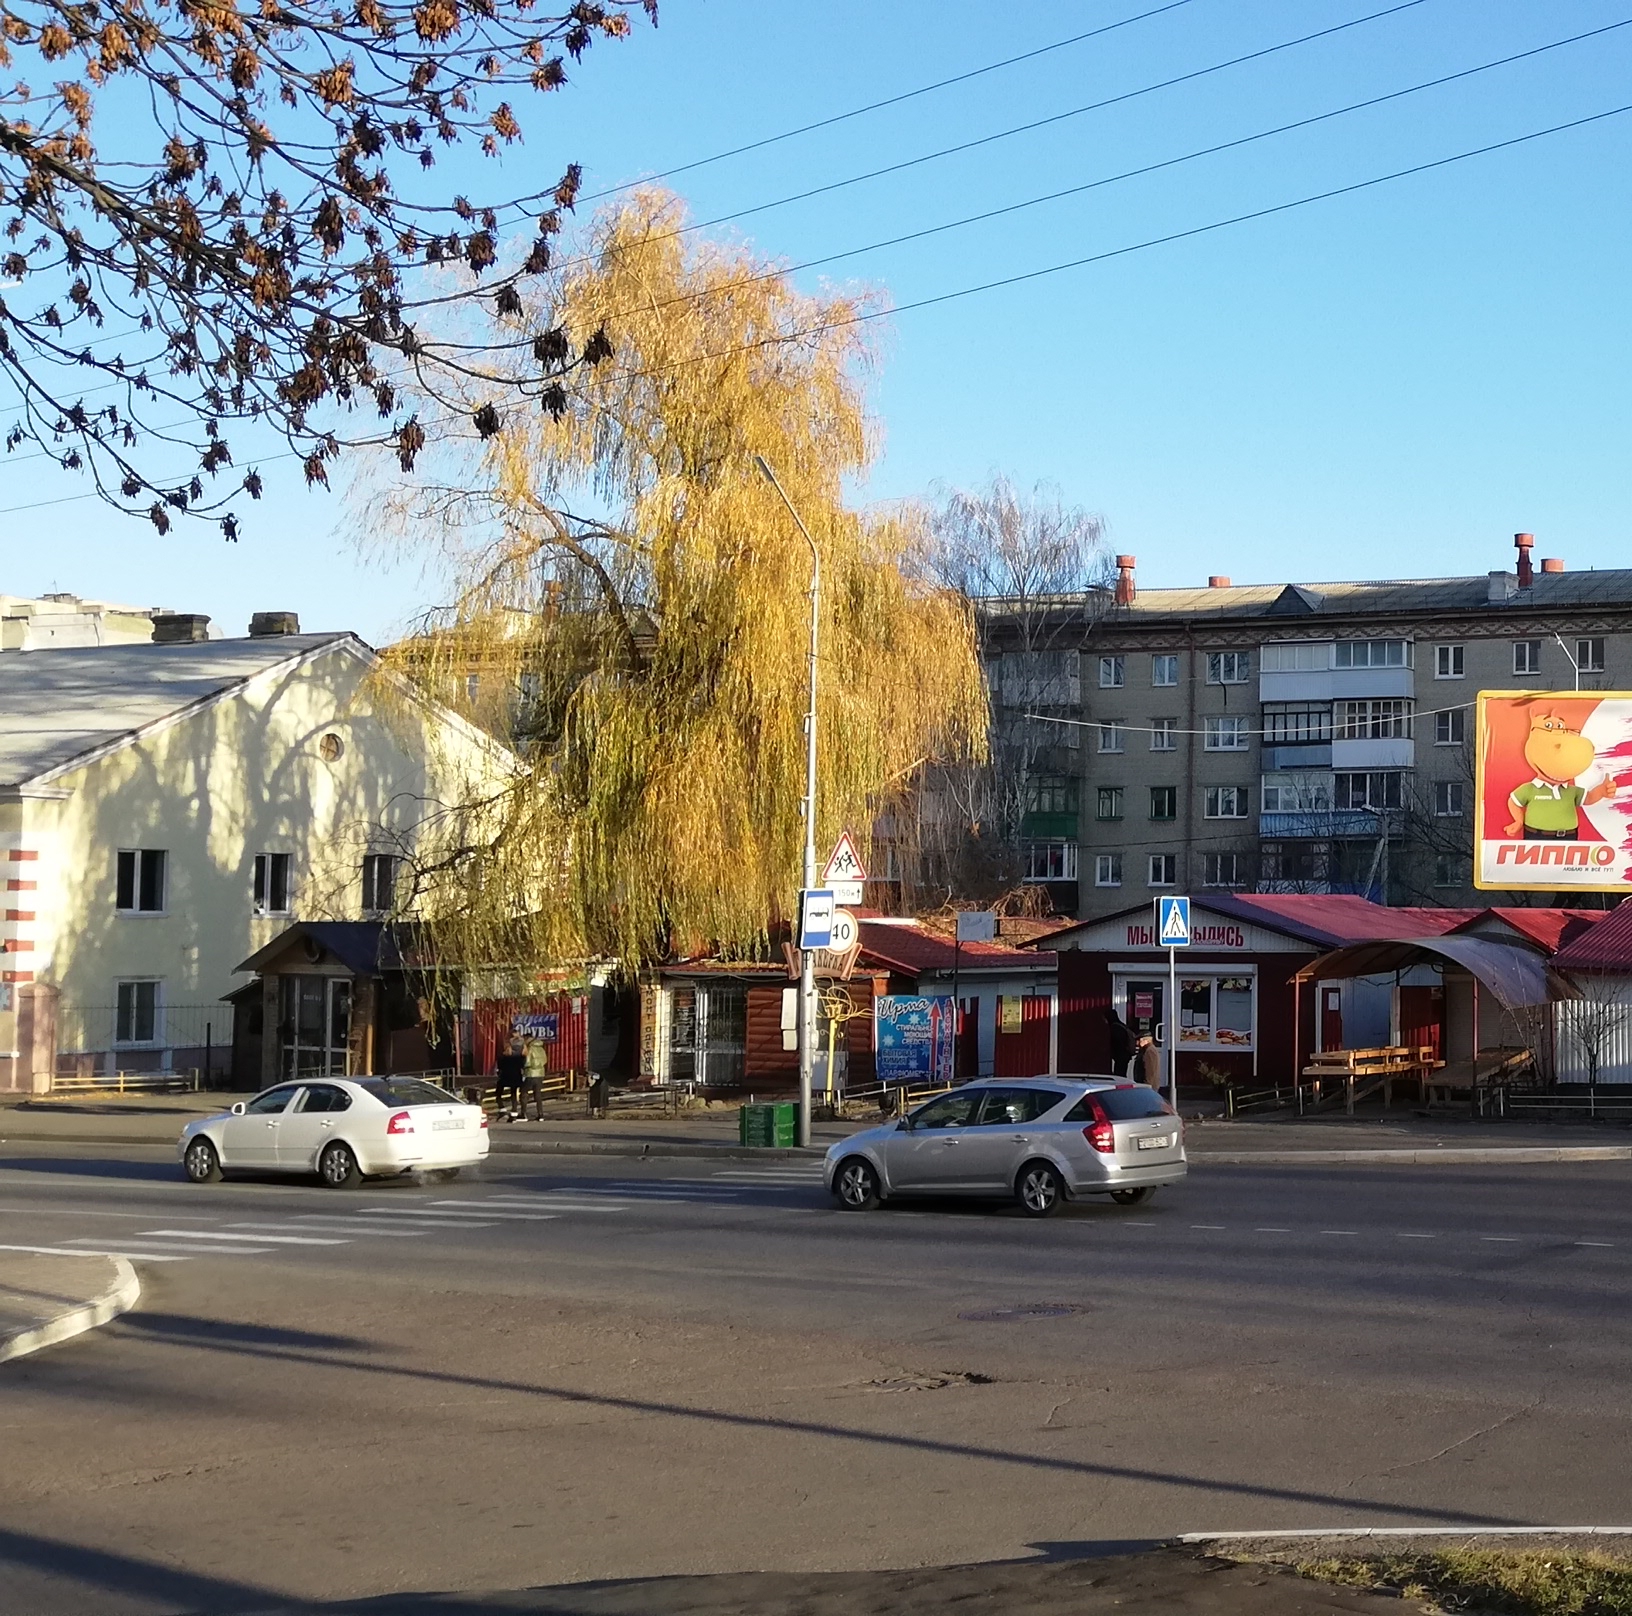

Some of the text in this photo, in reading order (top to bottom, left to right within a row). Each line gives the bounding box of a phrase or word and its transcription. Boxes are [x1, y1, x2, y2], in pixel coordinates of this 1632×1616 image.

[1496, 845, 1616, 866] ГИППО
[832, 923, 850, 940] 40
[1127, 926, 1153, 946] МЫ
